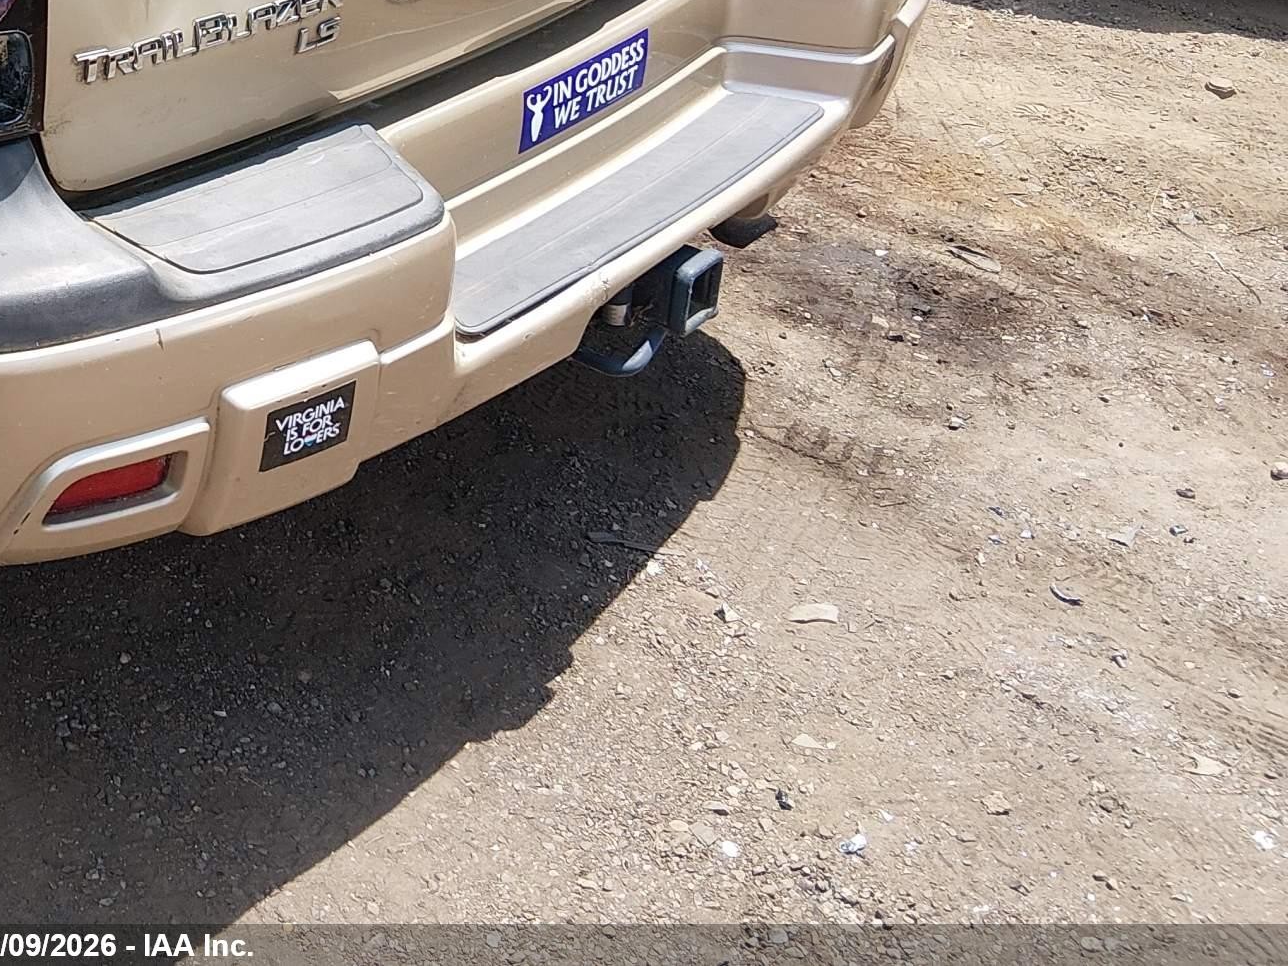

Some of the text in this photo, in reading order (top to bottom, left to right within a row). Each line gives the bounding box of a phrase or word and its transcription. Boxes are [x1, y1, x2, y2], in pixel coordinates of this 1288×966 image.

[295, 16, 342, 55] LS
[553, 38, 644, 106] IN GODDESS
[554, 65, 638, 128] WE TRUST
[275, 396, 345, 431] VIRGINIA
[286, 415, 333, 442] IS FOR
